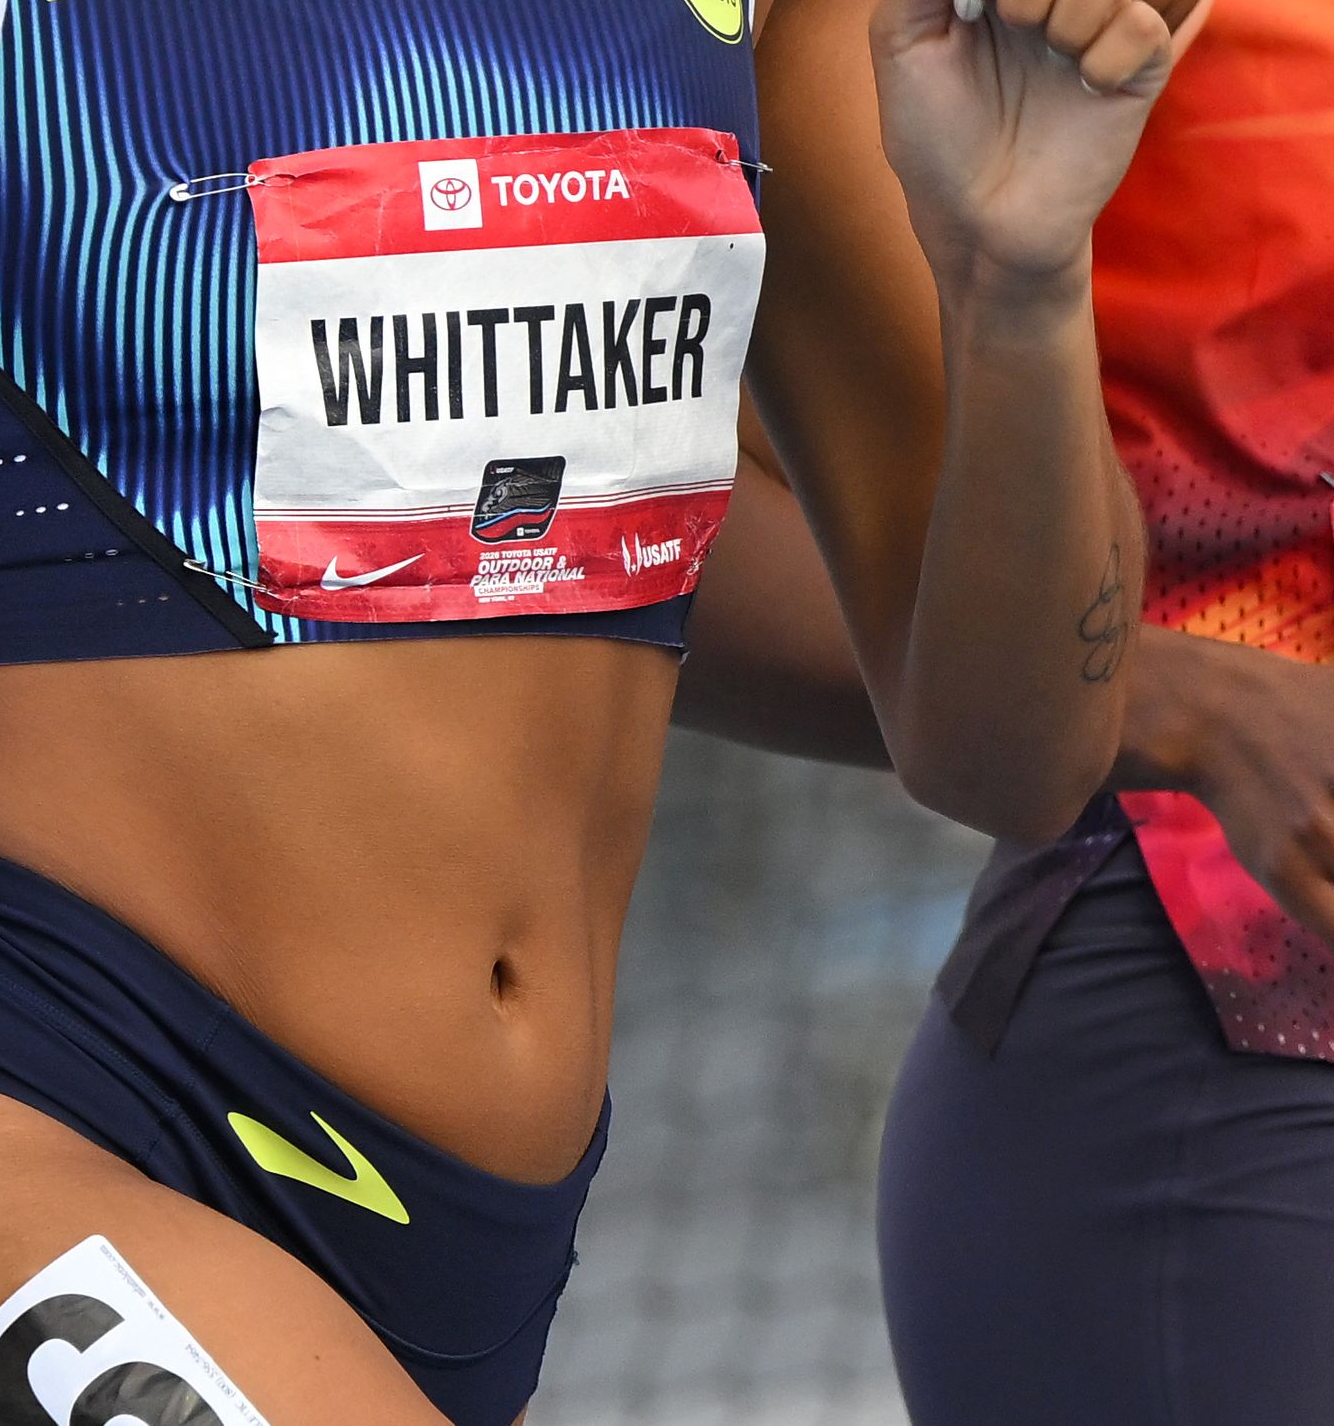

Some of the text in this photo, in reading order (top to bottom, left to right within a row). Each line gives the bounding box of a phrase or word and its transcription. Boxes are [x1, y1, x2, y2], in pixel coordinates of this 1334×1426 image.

[491, 170, 630, 207] TOYOTA
[311, 292, 712, 427] WHITTAKER
[502, 549, 532, 559] TOYOTA
[533, 547, 558, 556] USATF
[642, 538, 683, 568] USATF
[478, 555, 567, 575] OUTDOOR &
[470, 567, 586, 588] PARA NATIONAL
[478, 584, 540, 595] CHAMPIONSHIPS
